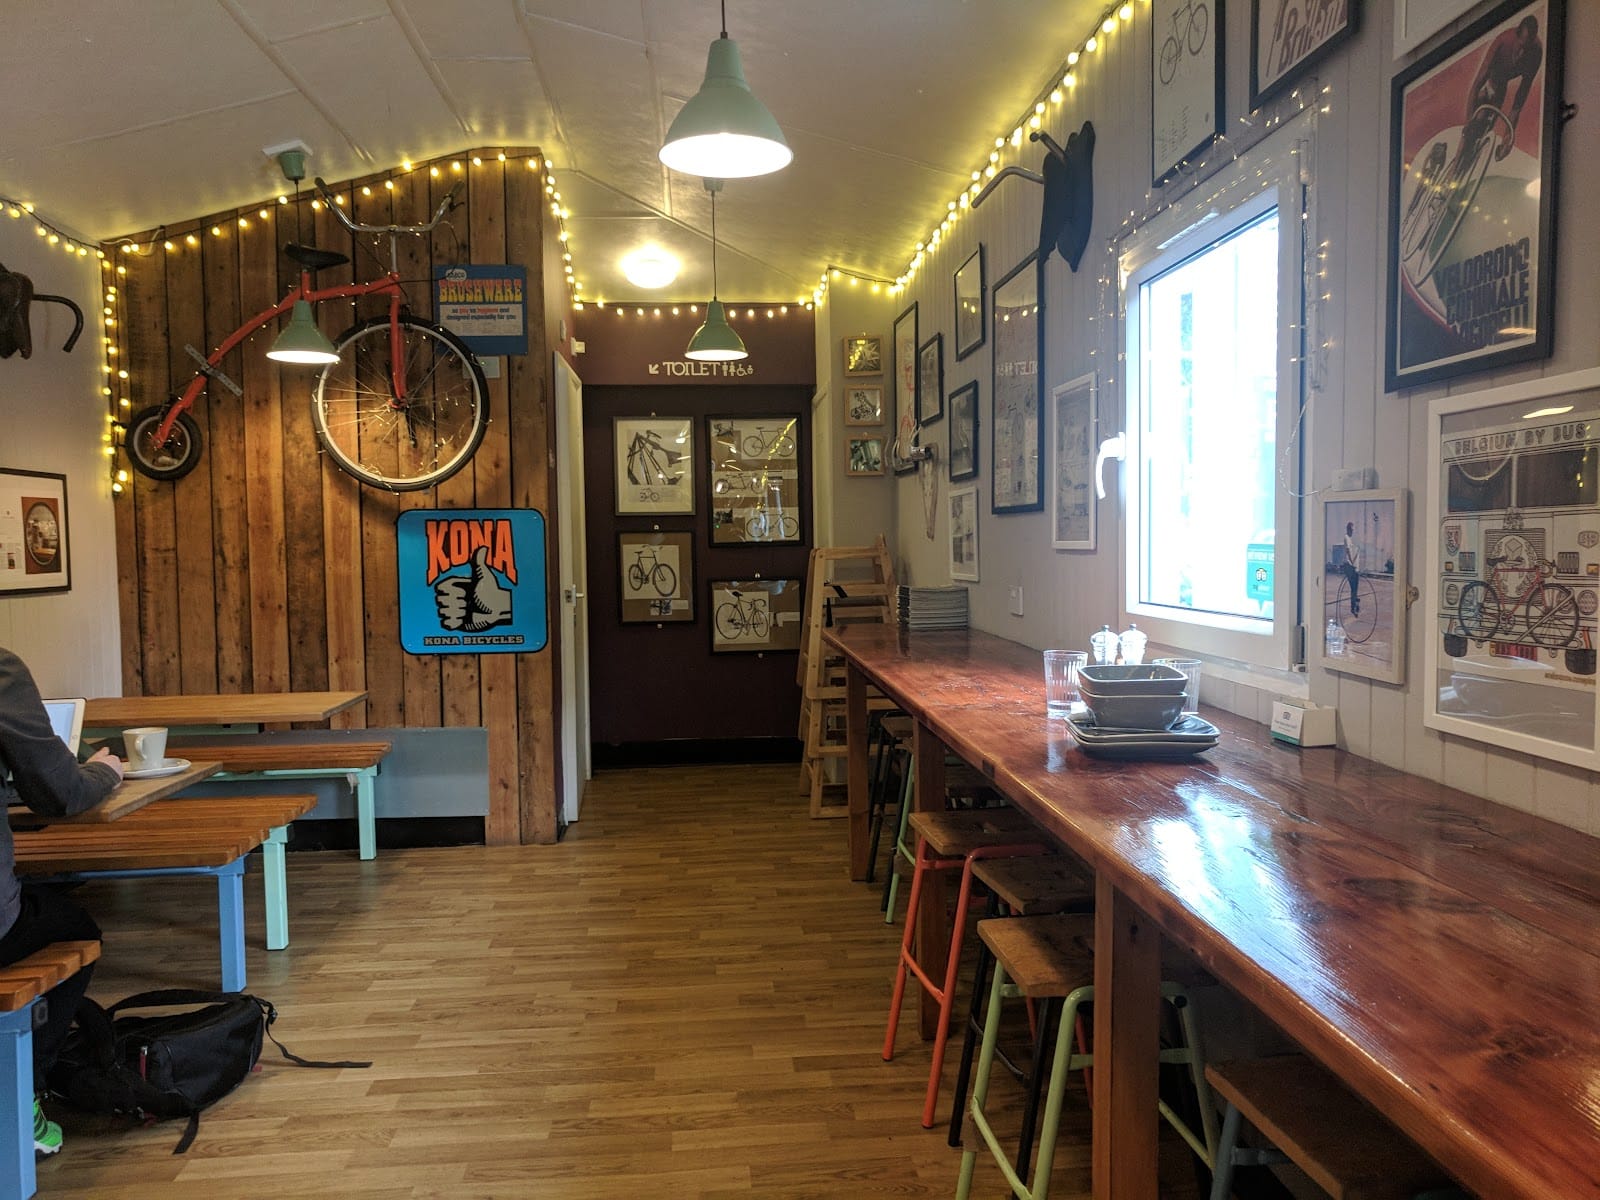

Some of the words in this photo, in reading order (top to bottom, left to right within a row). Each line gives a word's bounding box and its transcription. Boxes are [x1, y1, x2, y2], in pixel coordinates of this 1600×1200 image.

[1434, 237, 1530, 298] VELODROMO
[439, 279, 522, 302] BRUSHWARE
[663, 361, 721, 376] TOILET
[1454, 433, 1516, 455] BELGIUM
[1524, 429, 1545, 446] BY
[1552, 423, 1586, 442] BUS
[425, 519, 518, 586] KONA
[424, 637, 459, 645] KONA
[463, 636, 523, 645] BICYCLES
